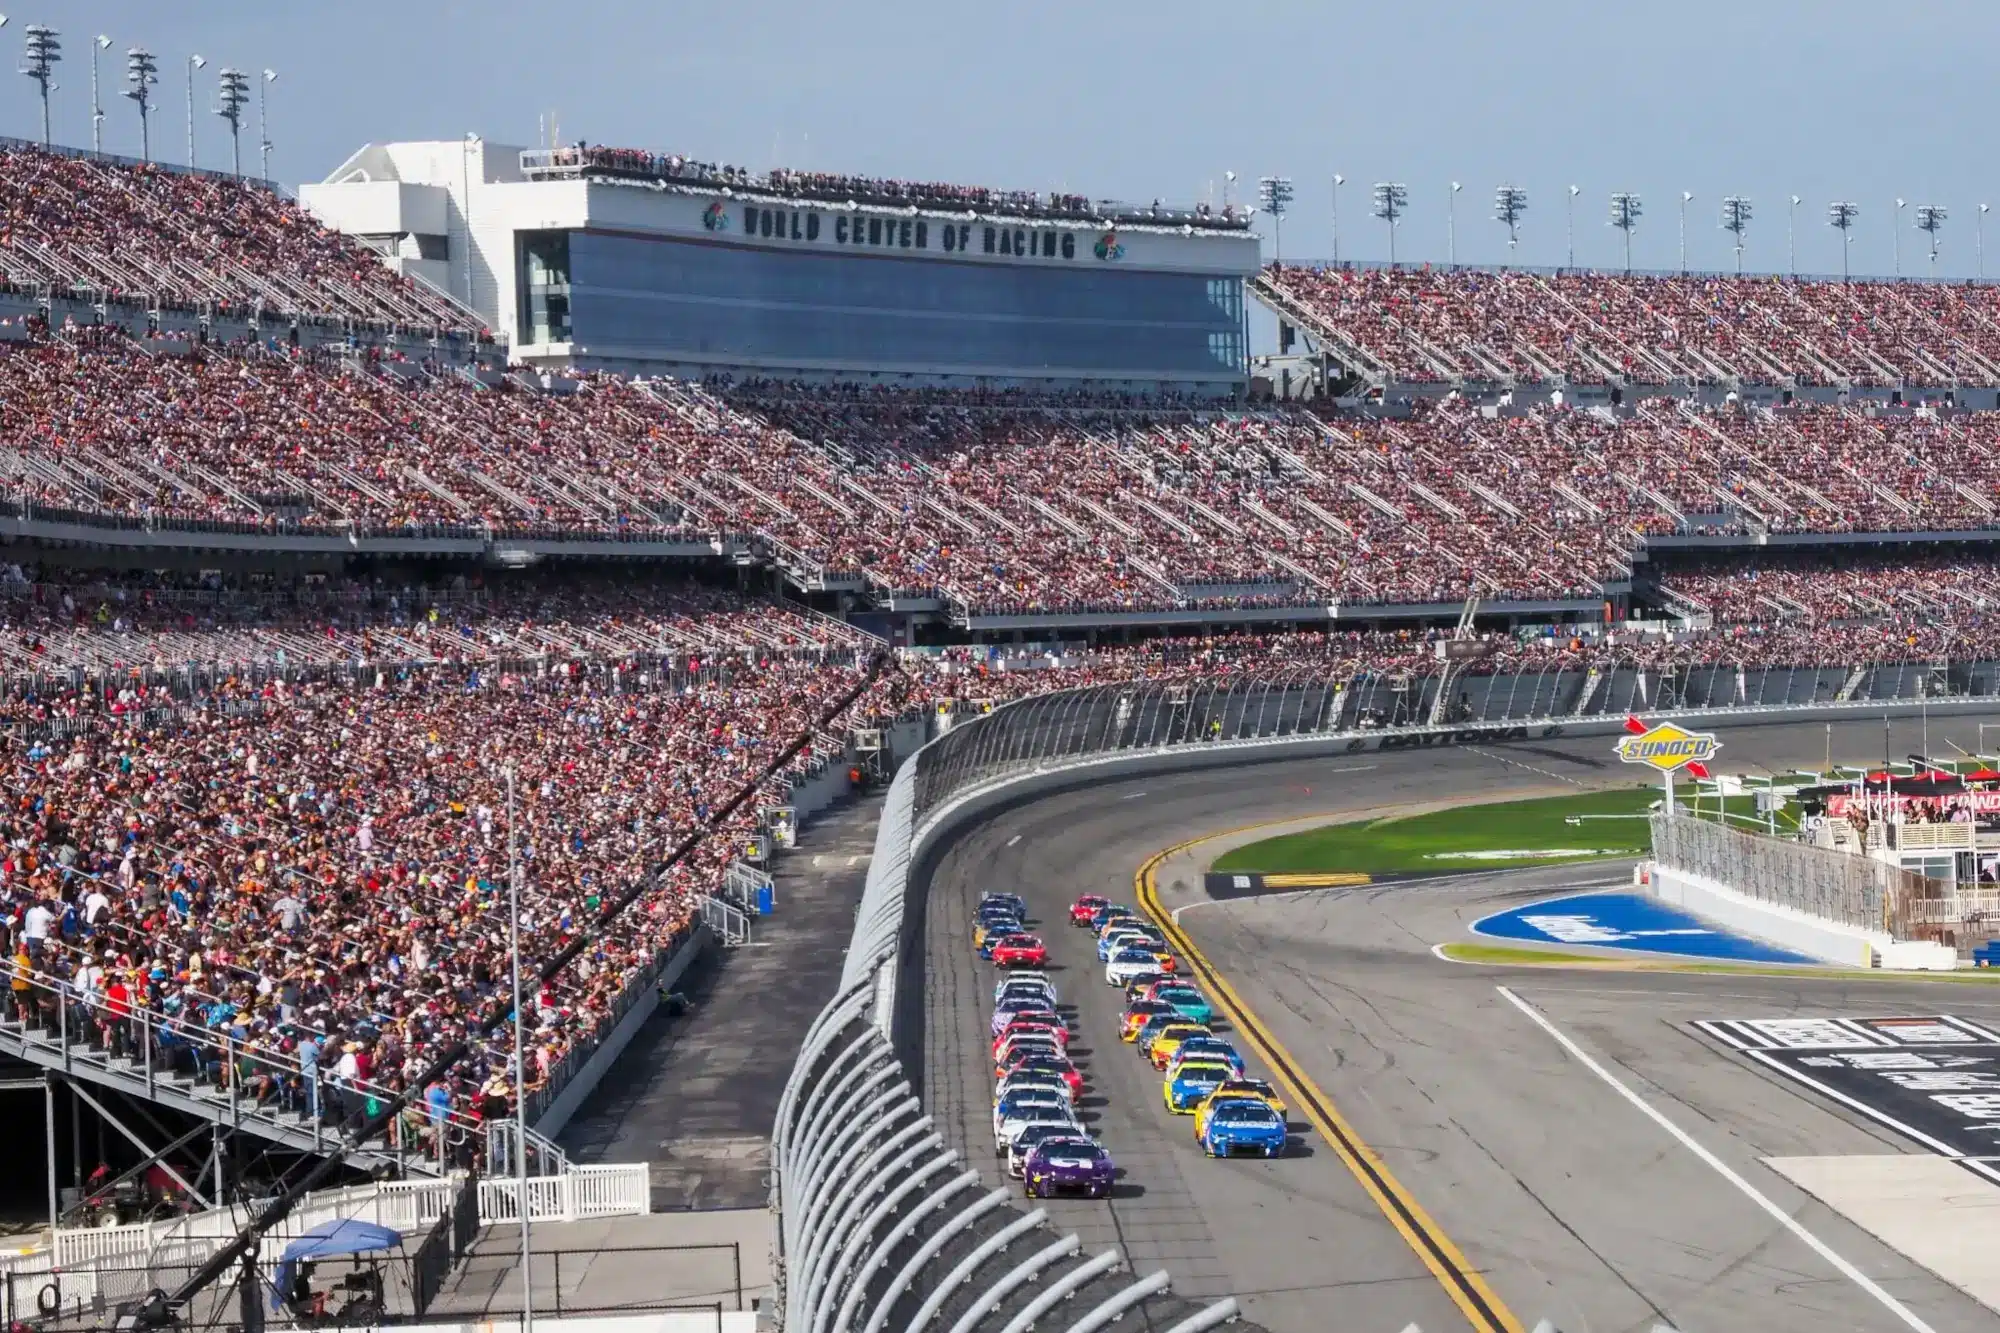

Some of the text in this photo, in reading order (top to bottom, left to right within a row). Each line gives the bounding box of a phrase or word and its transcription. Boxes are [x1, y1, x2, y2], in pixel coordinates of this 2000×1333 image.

[744, 206, 1075, 259] WORLD CENTER OF RACING
[1628, 740, 1709, 757] SUNOCO
